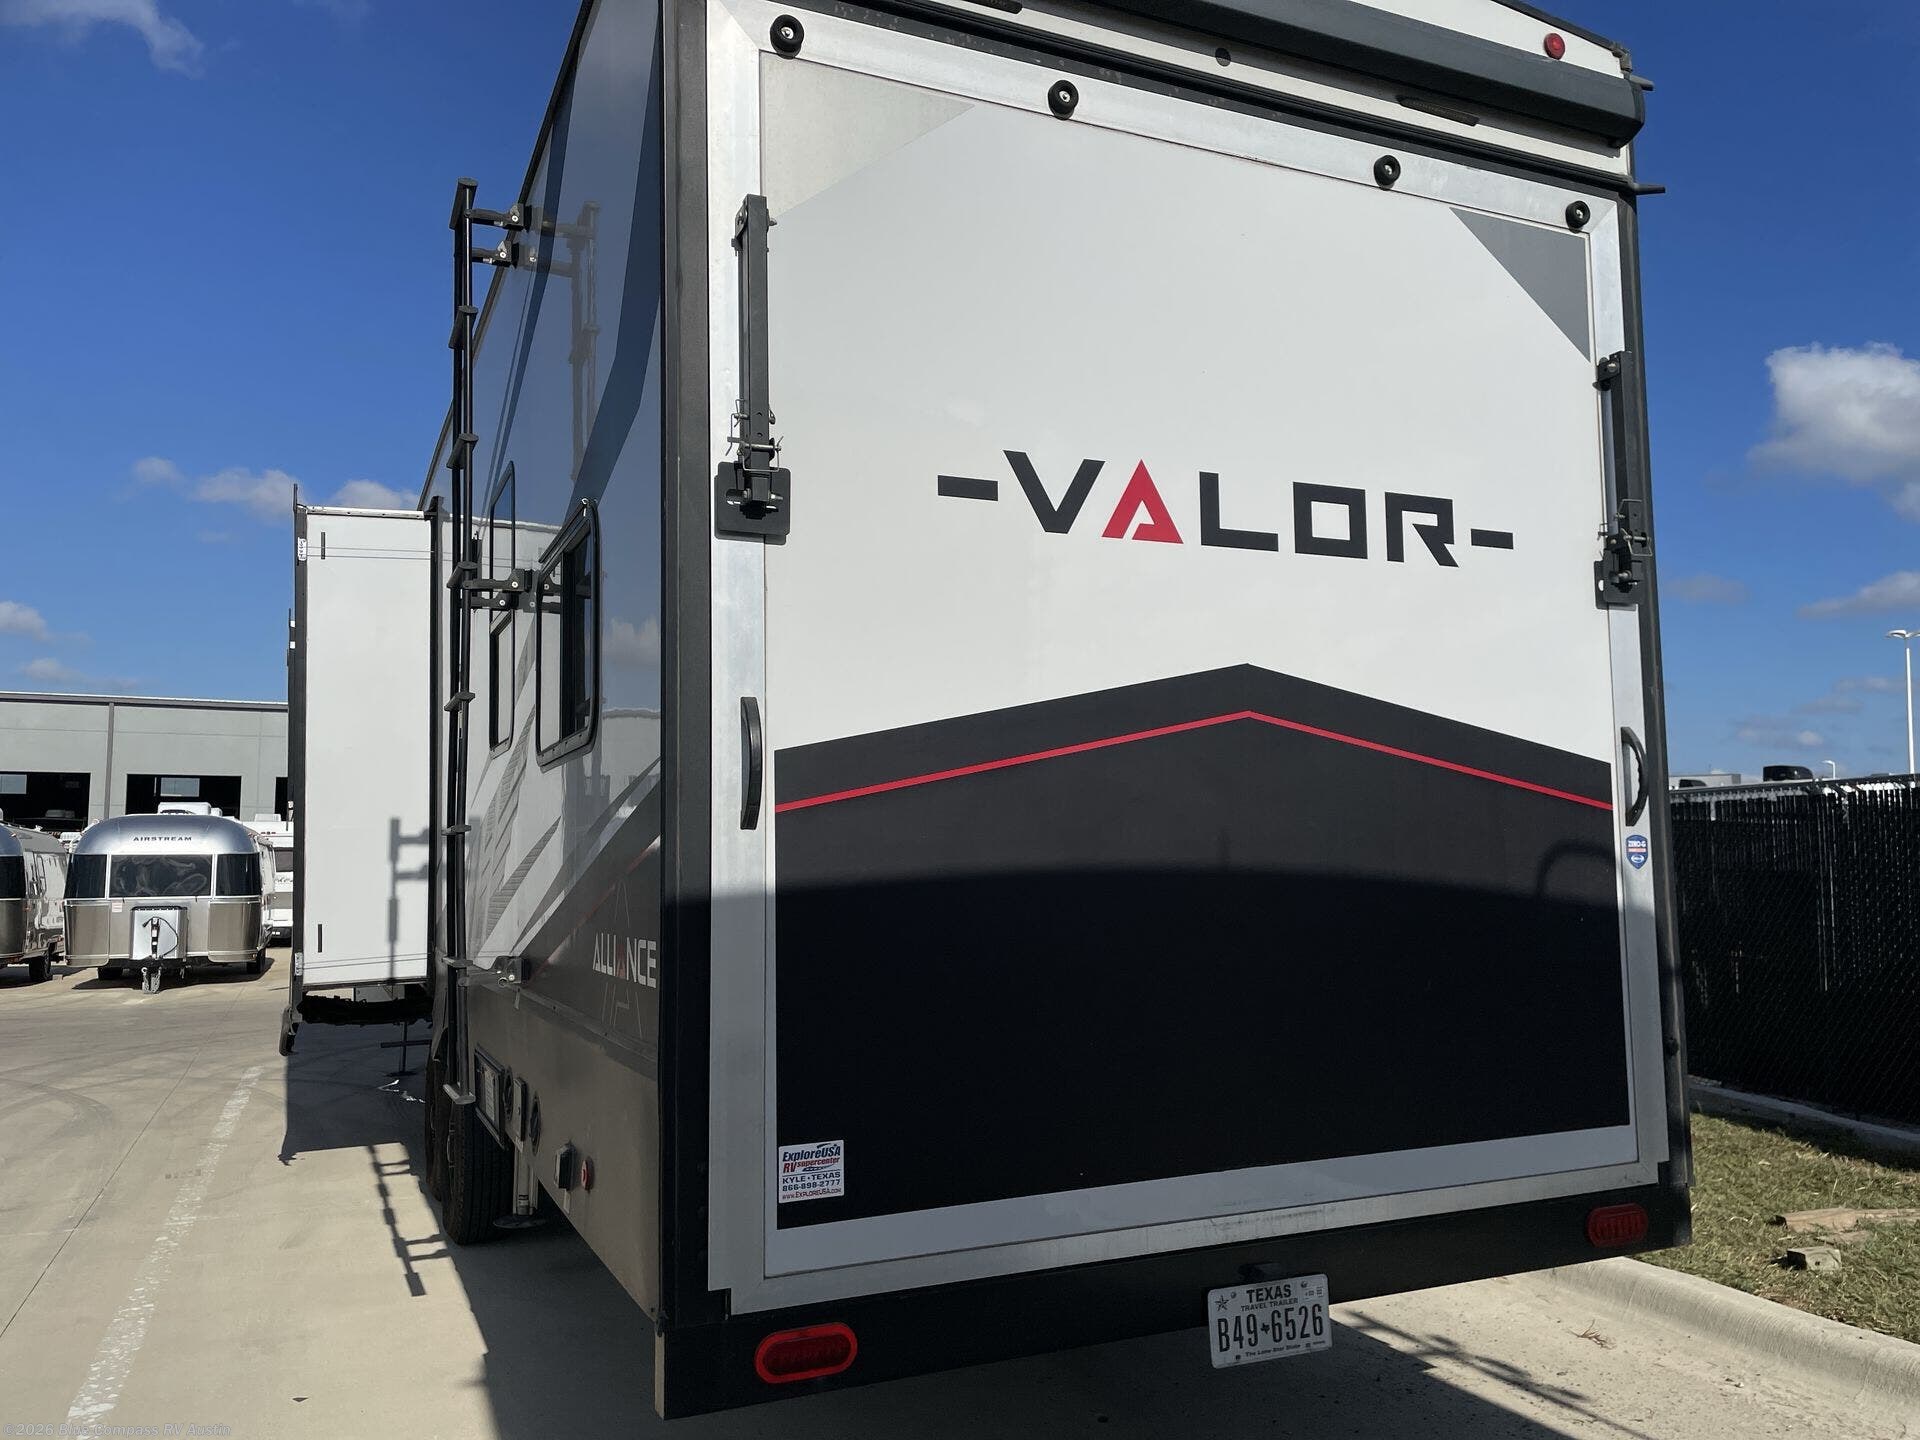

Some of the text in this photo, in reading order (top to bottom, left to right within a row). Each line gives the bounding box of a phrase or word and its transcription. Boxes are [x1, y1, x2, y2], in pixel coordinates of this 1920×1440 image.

[592, 932, 657, 989] ALLIANCE
[782, 1145, 841, 1162] ExploreUSA
[783, 1161, 797, 1174] RV
[782, 1171, 841, 1185] KYLE TEXAS
[782, 1179, 841, 1192] 866-898-2777
[1246, 1284, 1292, 1303] TEXAS
[1240, 1298, 1299, 1312] TRAVEL TRAILER
